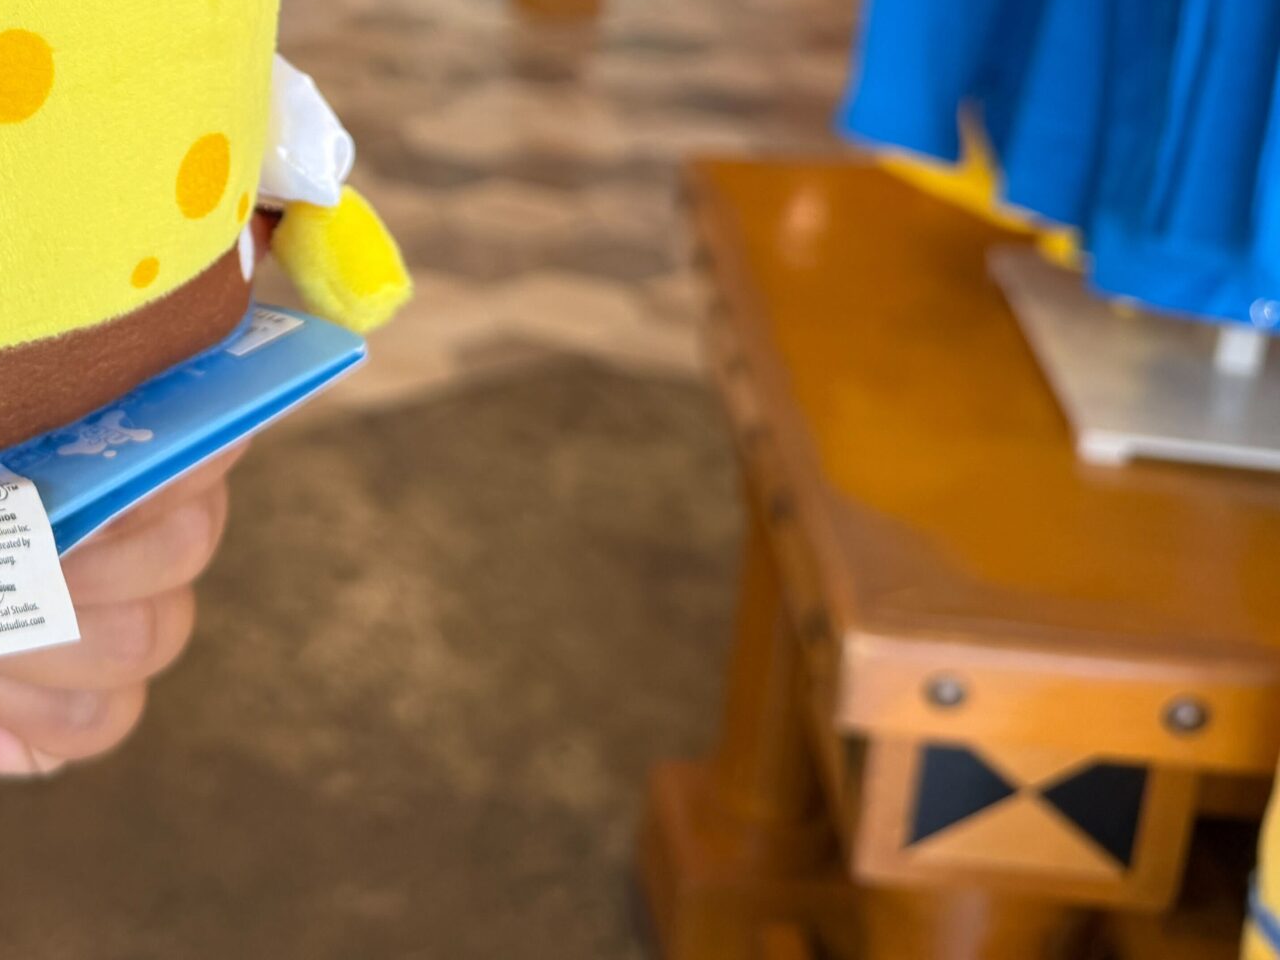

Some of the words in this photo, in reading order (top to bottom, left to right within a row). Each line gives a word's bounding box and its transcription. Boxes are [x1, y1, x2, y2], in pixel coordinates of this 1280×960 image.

[18, 524, 31, 533] Inc.
[22, 537, 31, 548] by
[11, 602, 40, 615] Studios.
